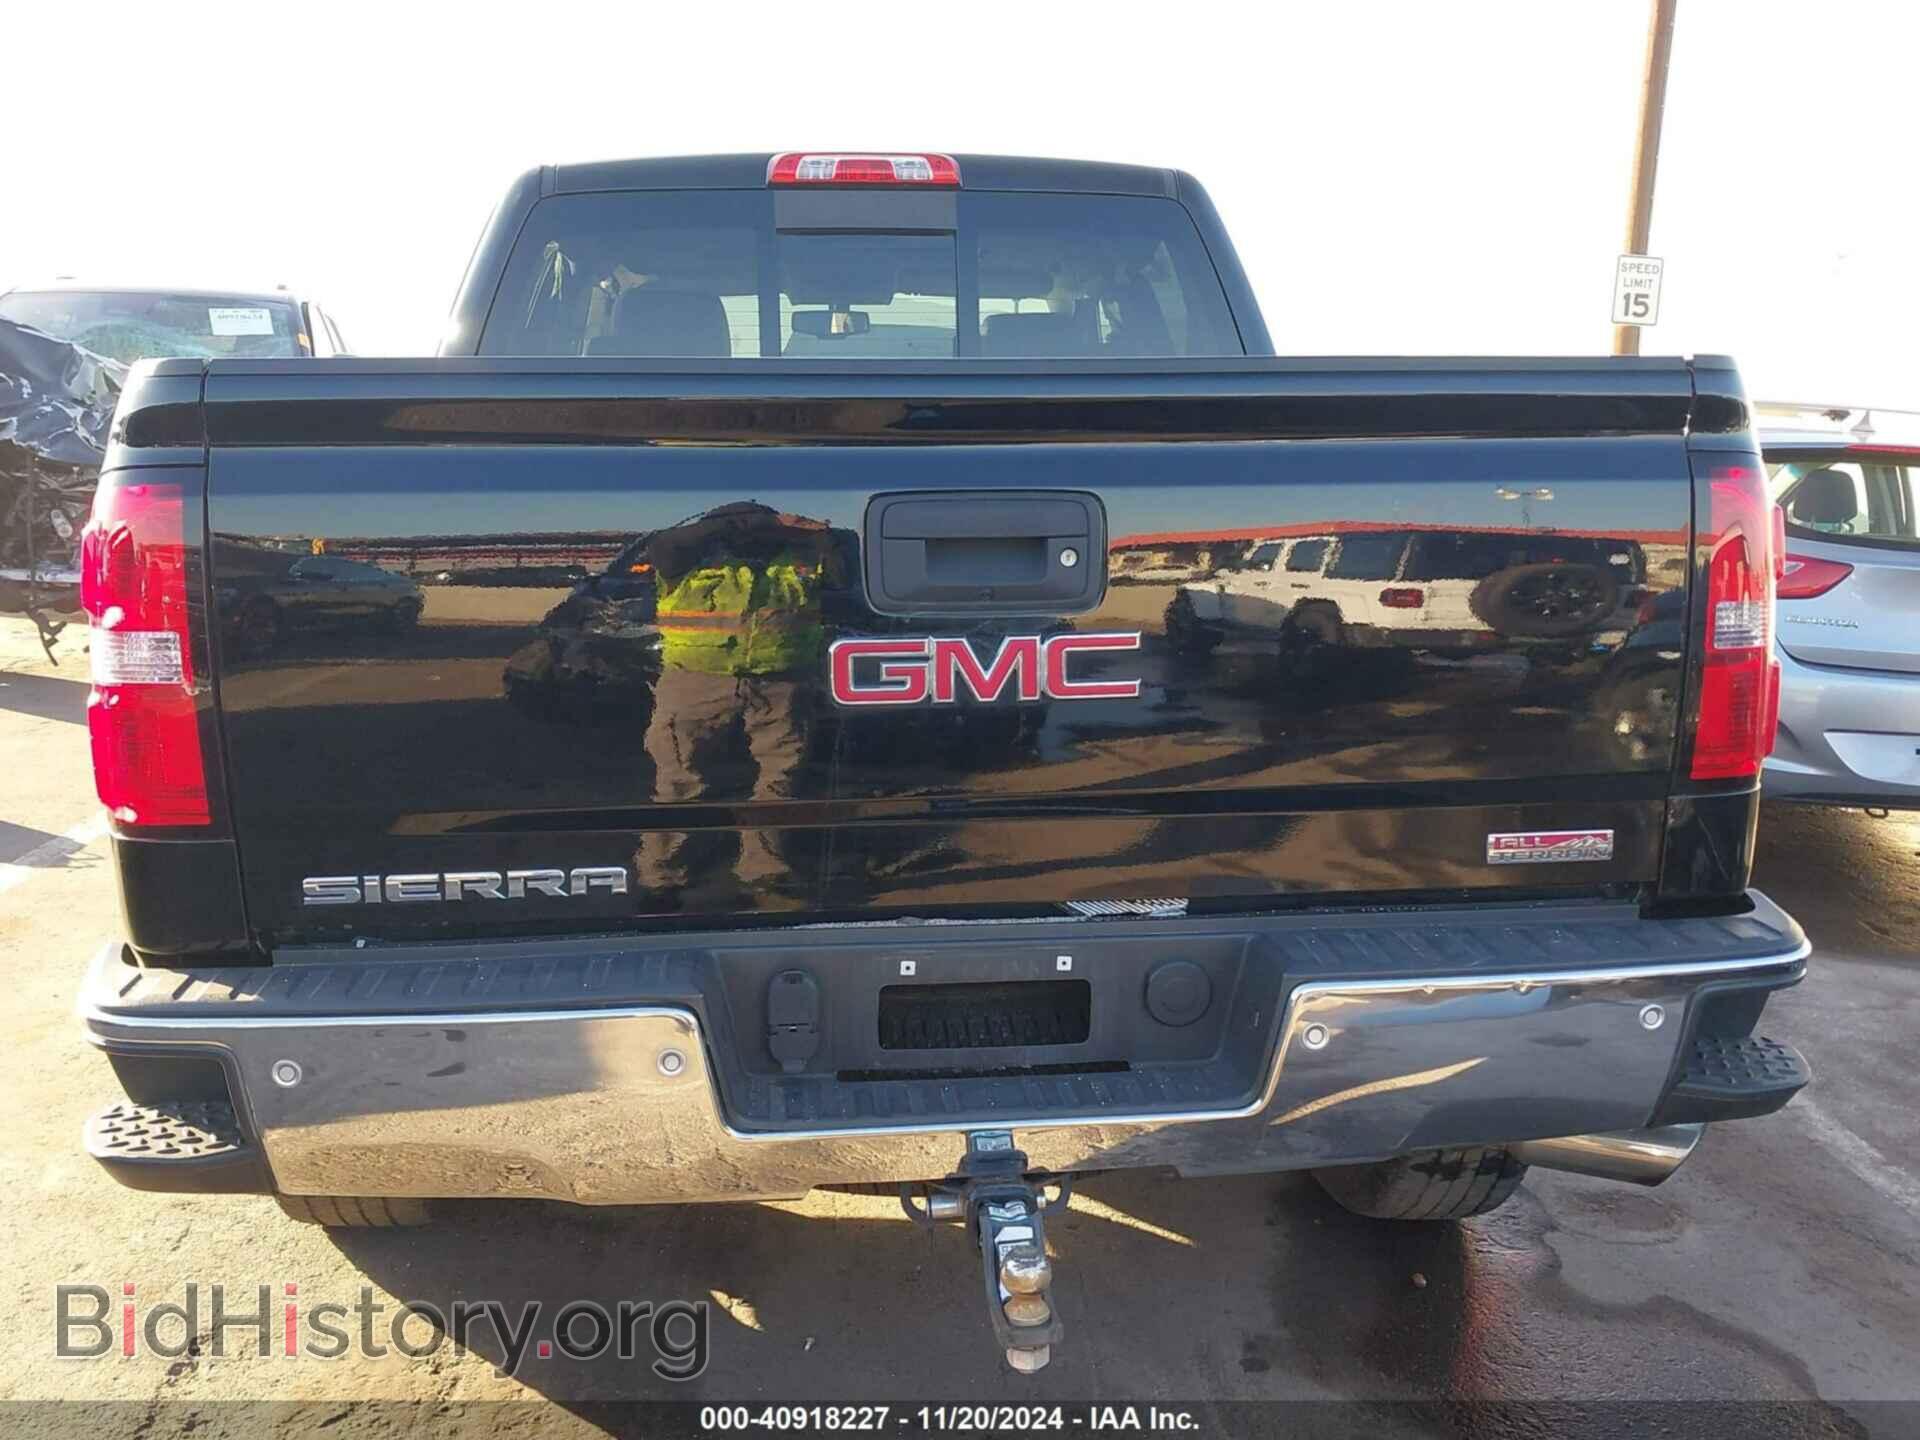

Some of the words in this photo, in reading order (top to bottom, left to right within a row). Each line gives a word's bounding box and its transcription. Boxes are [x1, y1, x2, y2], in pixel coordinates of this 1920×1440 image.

[1621, 262, 1659, 274] SPEED
[1623, 278, 1653, 288] LIMIT
[1623, 292, 1649, 318] 15
[828, 631, 1142, 706] GMC
[1500, 836, 1550, 849] ALL
[1488, 846, 1612, 862] TERRAIN
[302, 866, 628, 905] SIERRA
